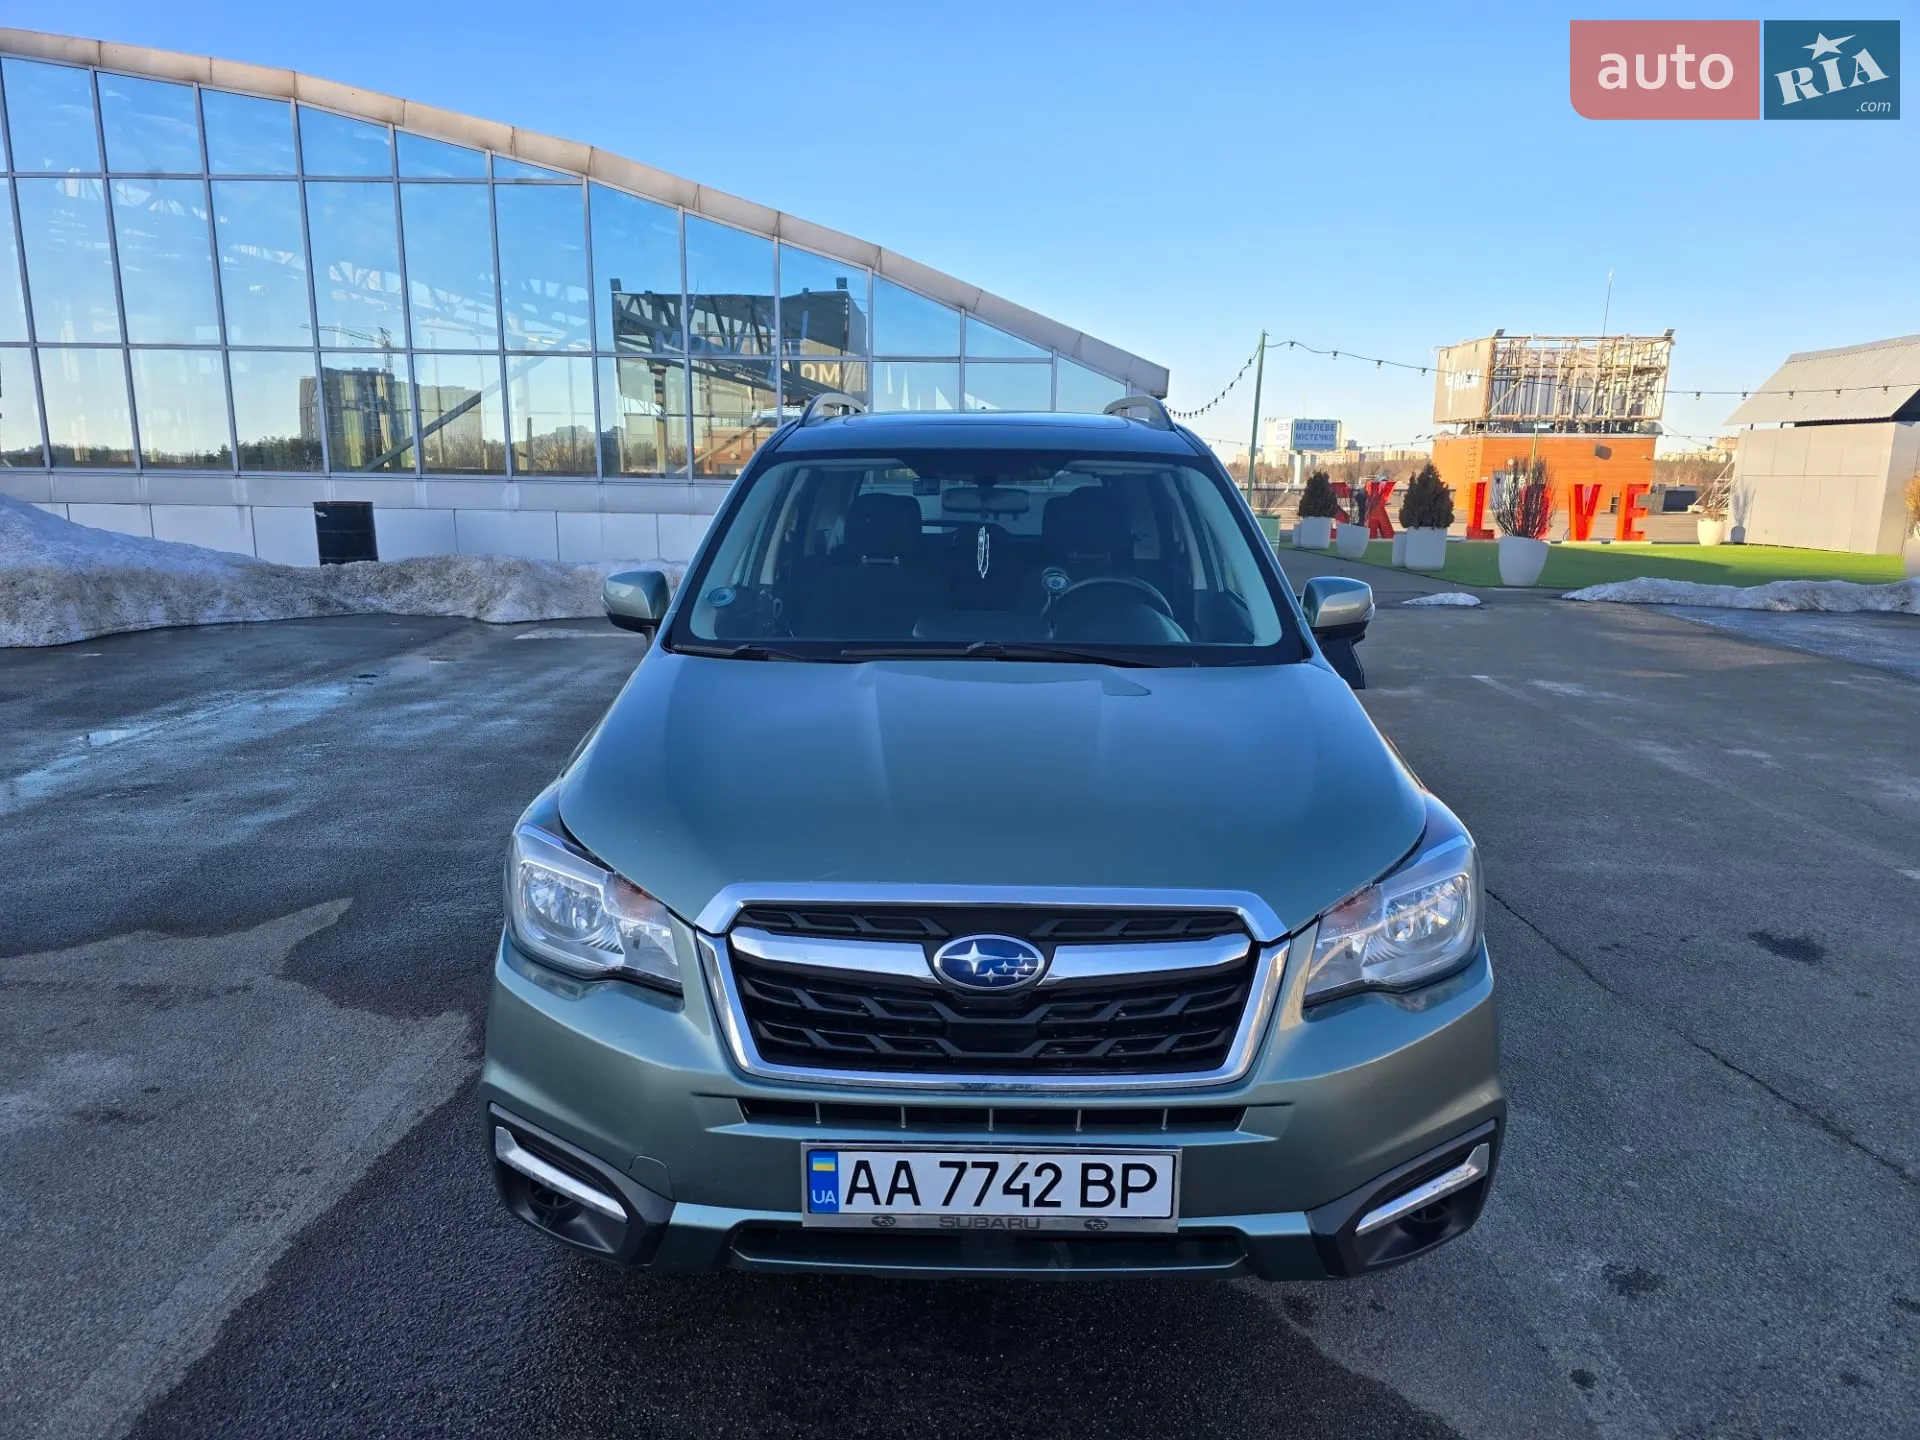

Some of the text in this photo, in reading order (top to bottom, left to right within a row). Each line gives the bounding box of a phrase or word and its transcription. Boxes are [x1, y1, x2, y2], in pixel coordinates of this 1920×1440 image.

[845, 1160, 1158, 1209] AA 7742 BP
[812, 1190, 837, 1204] UA
[939, 1216, 1041, 1230] SUBARU
